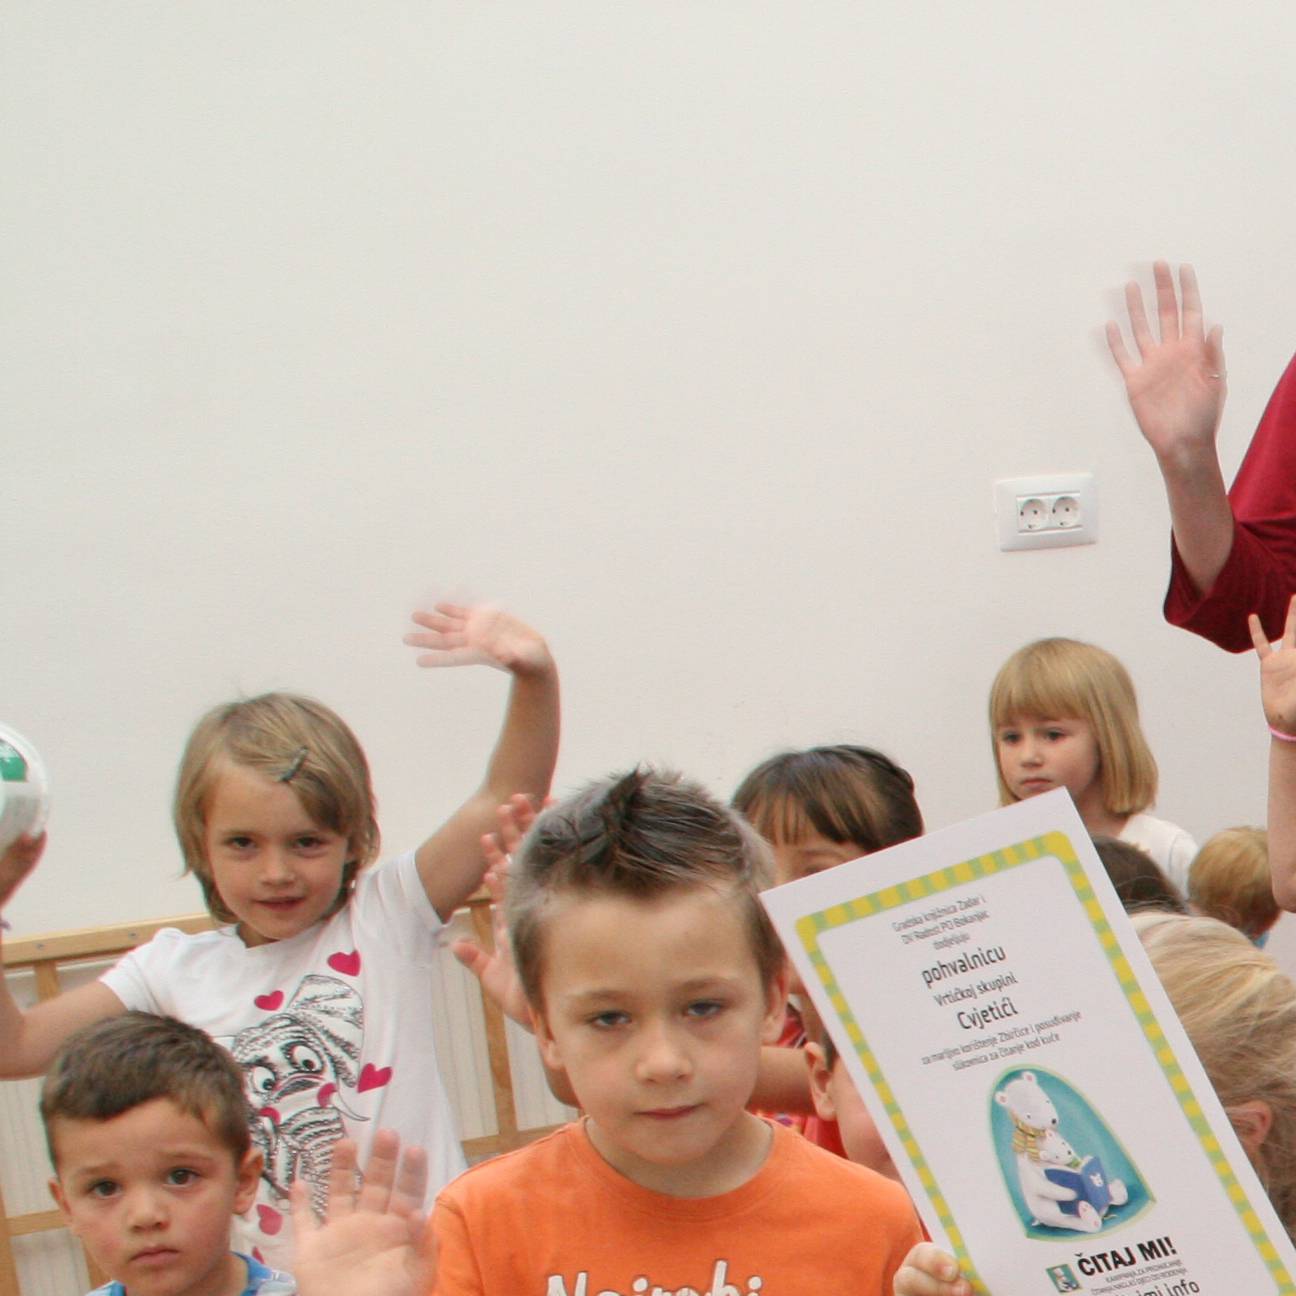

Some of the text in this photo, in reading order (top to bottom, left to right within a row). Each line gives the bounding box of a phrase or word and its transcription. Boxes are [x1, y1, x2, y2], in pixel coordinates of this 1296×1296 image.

[922, 945, 1007, 989] pohvalnicu
[977, 971, 1019, 995] skupini
[957, 996, 1019, 1031] Cvjetići
[1075, 1236, 1177, 1277] ČITAJ MI!
